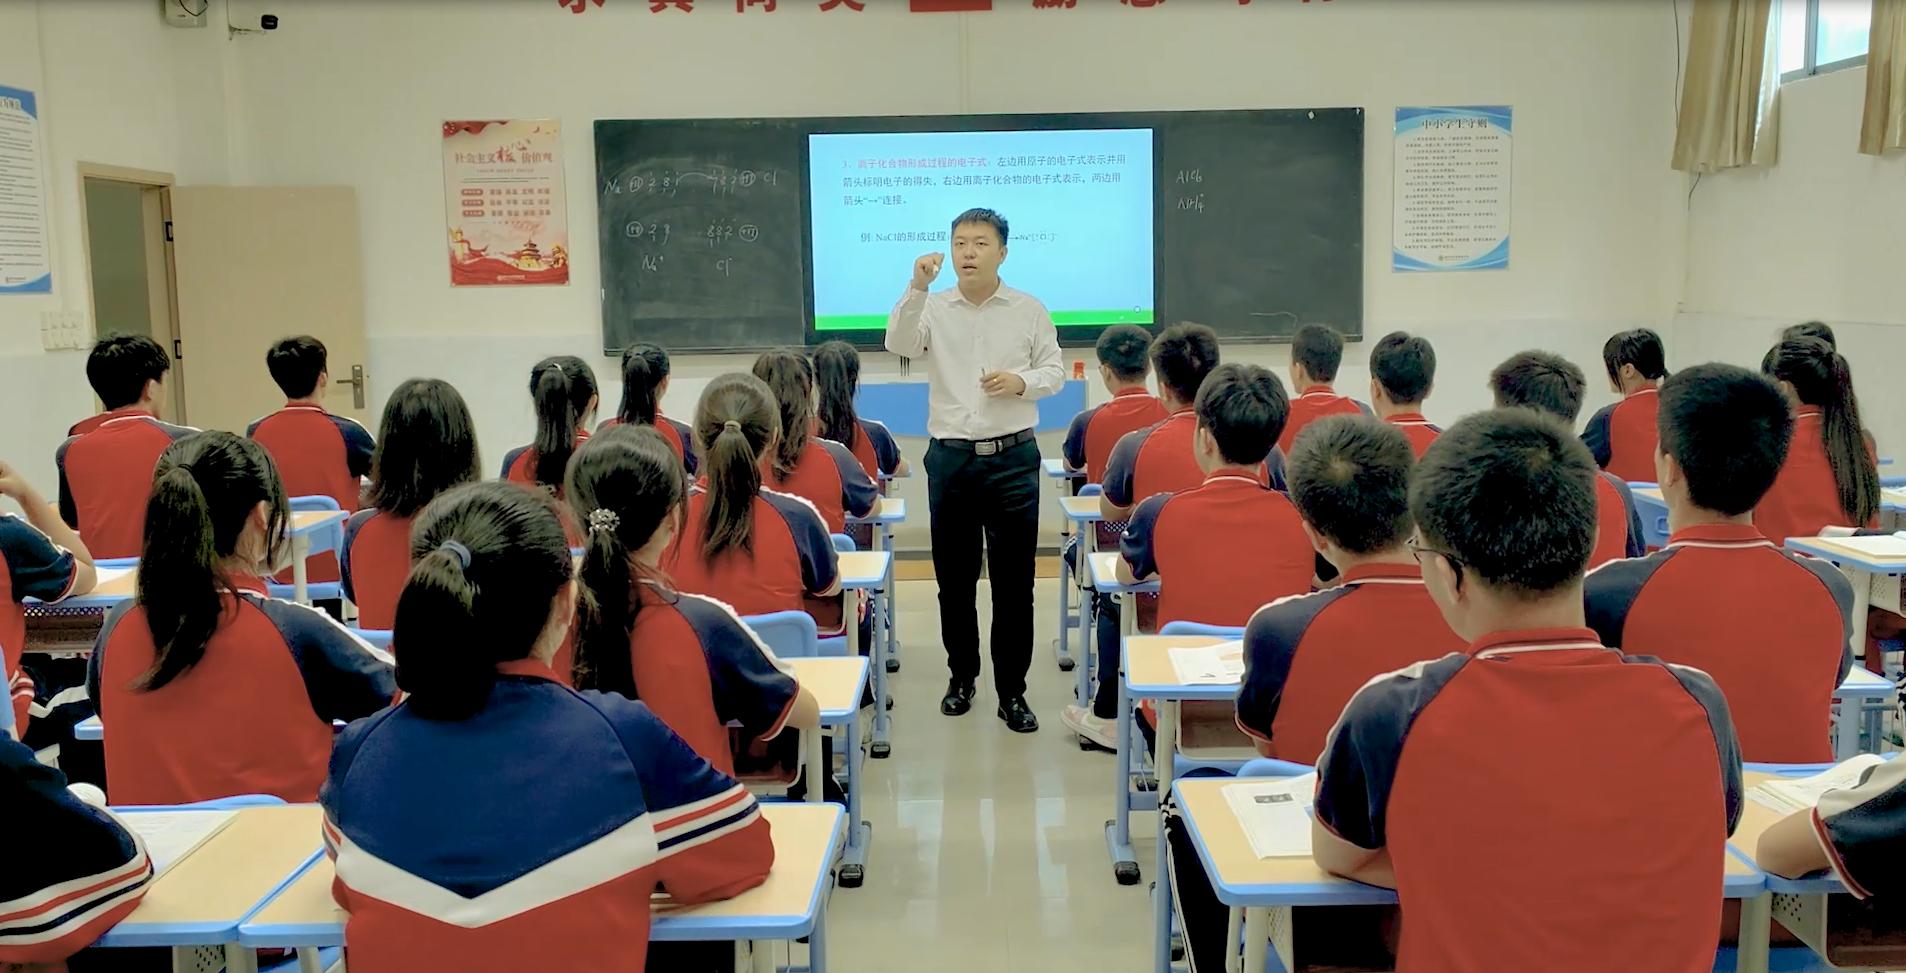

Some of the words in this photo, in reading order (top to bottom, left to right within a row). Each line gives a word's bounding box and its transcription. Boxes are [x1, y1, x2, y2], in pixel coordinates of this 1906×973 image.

[1422, 118, 1488, 130] 中小学生守则
